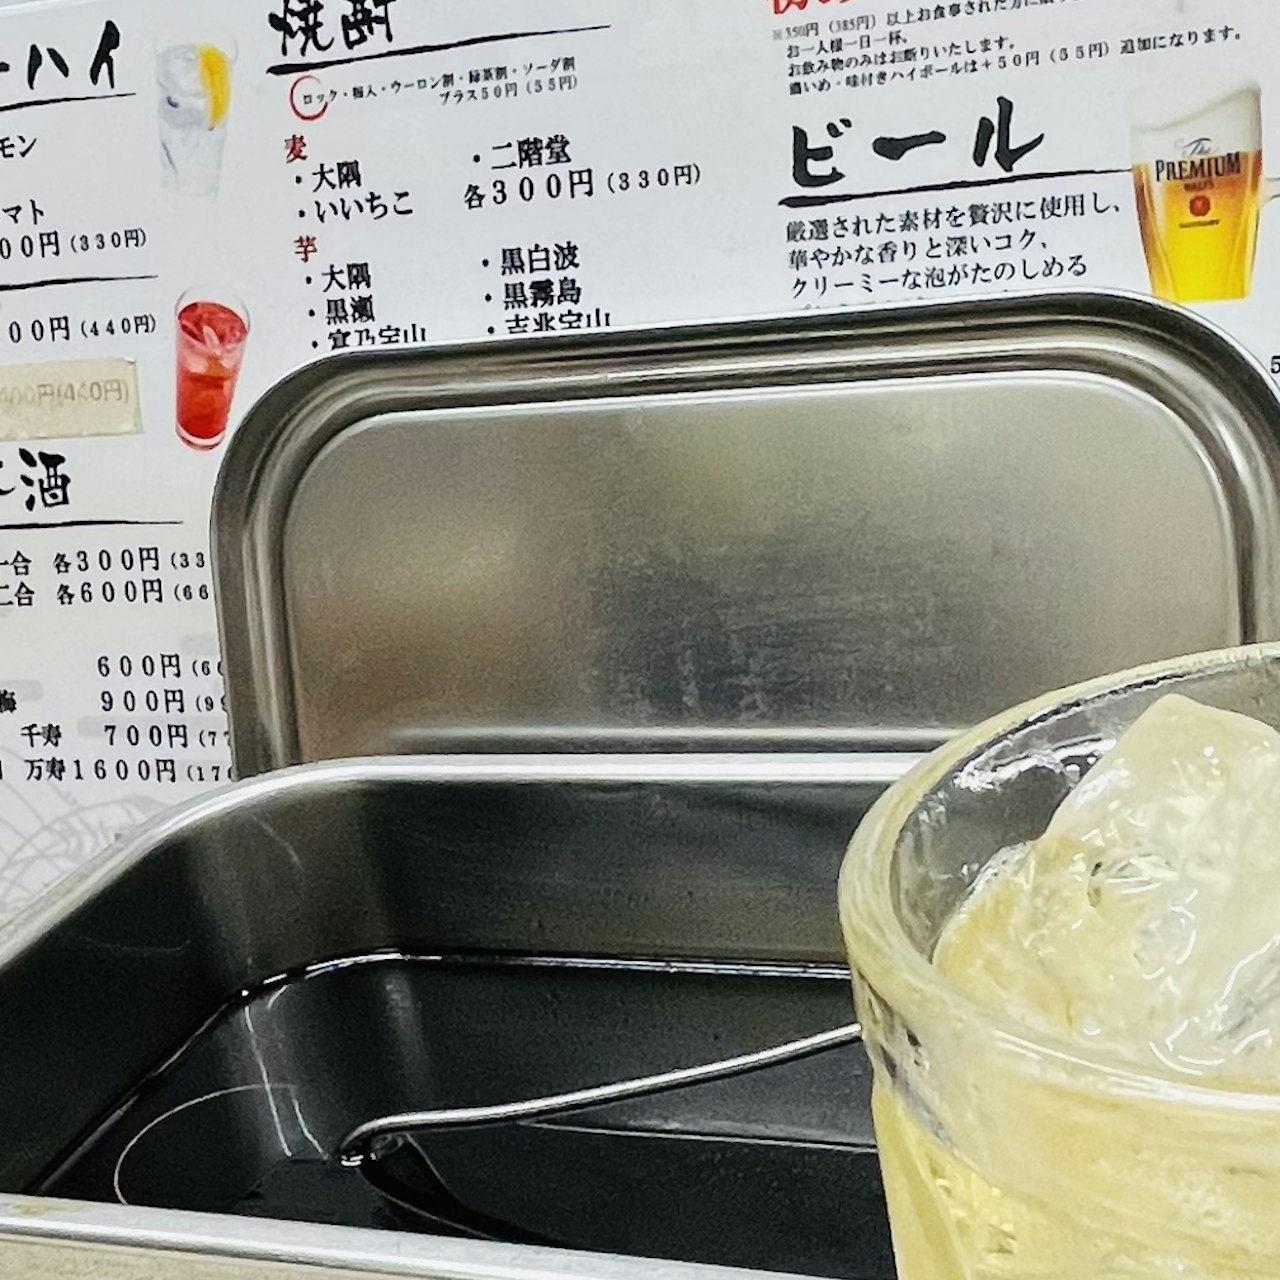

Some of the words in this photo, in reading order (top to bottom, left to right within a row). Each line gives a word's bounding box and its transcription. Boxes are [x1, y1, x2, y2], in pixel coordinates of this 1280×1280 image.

[284, 134, 309, 163] 麦
[792, 96, 1045, 191] ビール
[1155, 151, 1241, 182] PREMIUM
[294, 235, 319, 263] 芋
[792, 254, 1088, 298] クリーミーな泡がたのしめる
